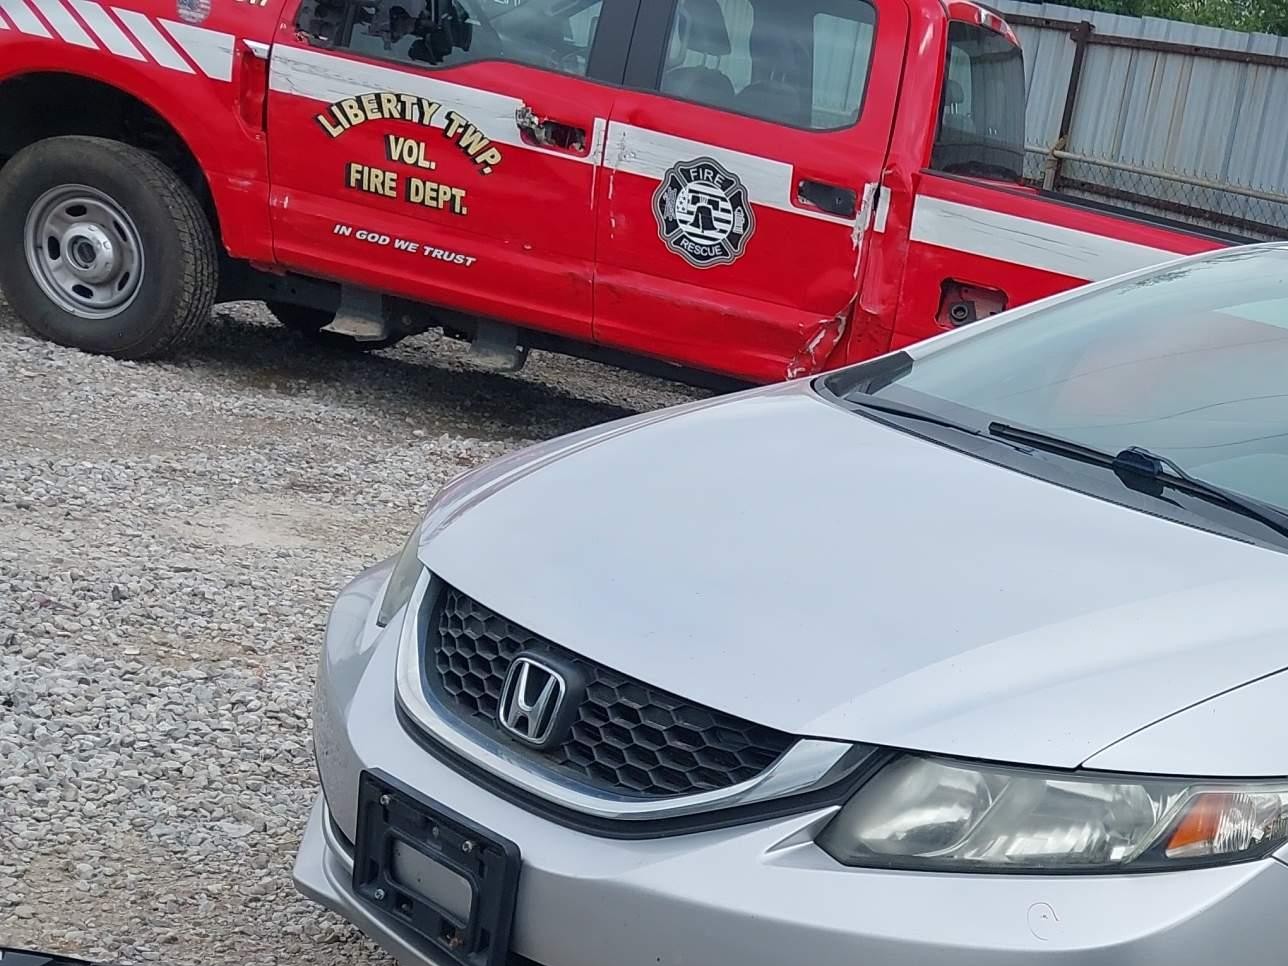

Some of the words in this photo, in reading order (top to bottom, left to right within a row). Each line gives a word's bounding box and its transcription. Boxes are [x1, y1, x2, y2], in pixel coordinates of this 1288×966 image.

[316, 92, 441, 138] LIBERTY
[445, 110, 502, 174] TWP.
[386, 134, 436, 170] VOL.
[348, 162, 398, 198] FIRE
[407, 176, 468, 215] DEPT.
[689, 167, 725, 188] FIRE
[333, 224, 352, 236] IN
[355, 229, 391, 246] GOD
[393, 238, 420, 253] WE
[423, 245, 477, 267] TRUST
[679, 238, 723, 256] RESCUE
